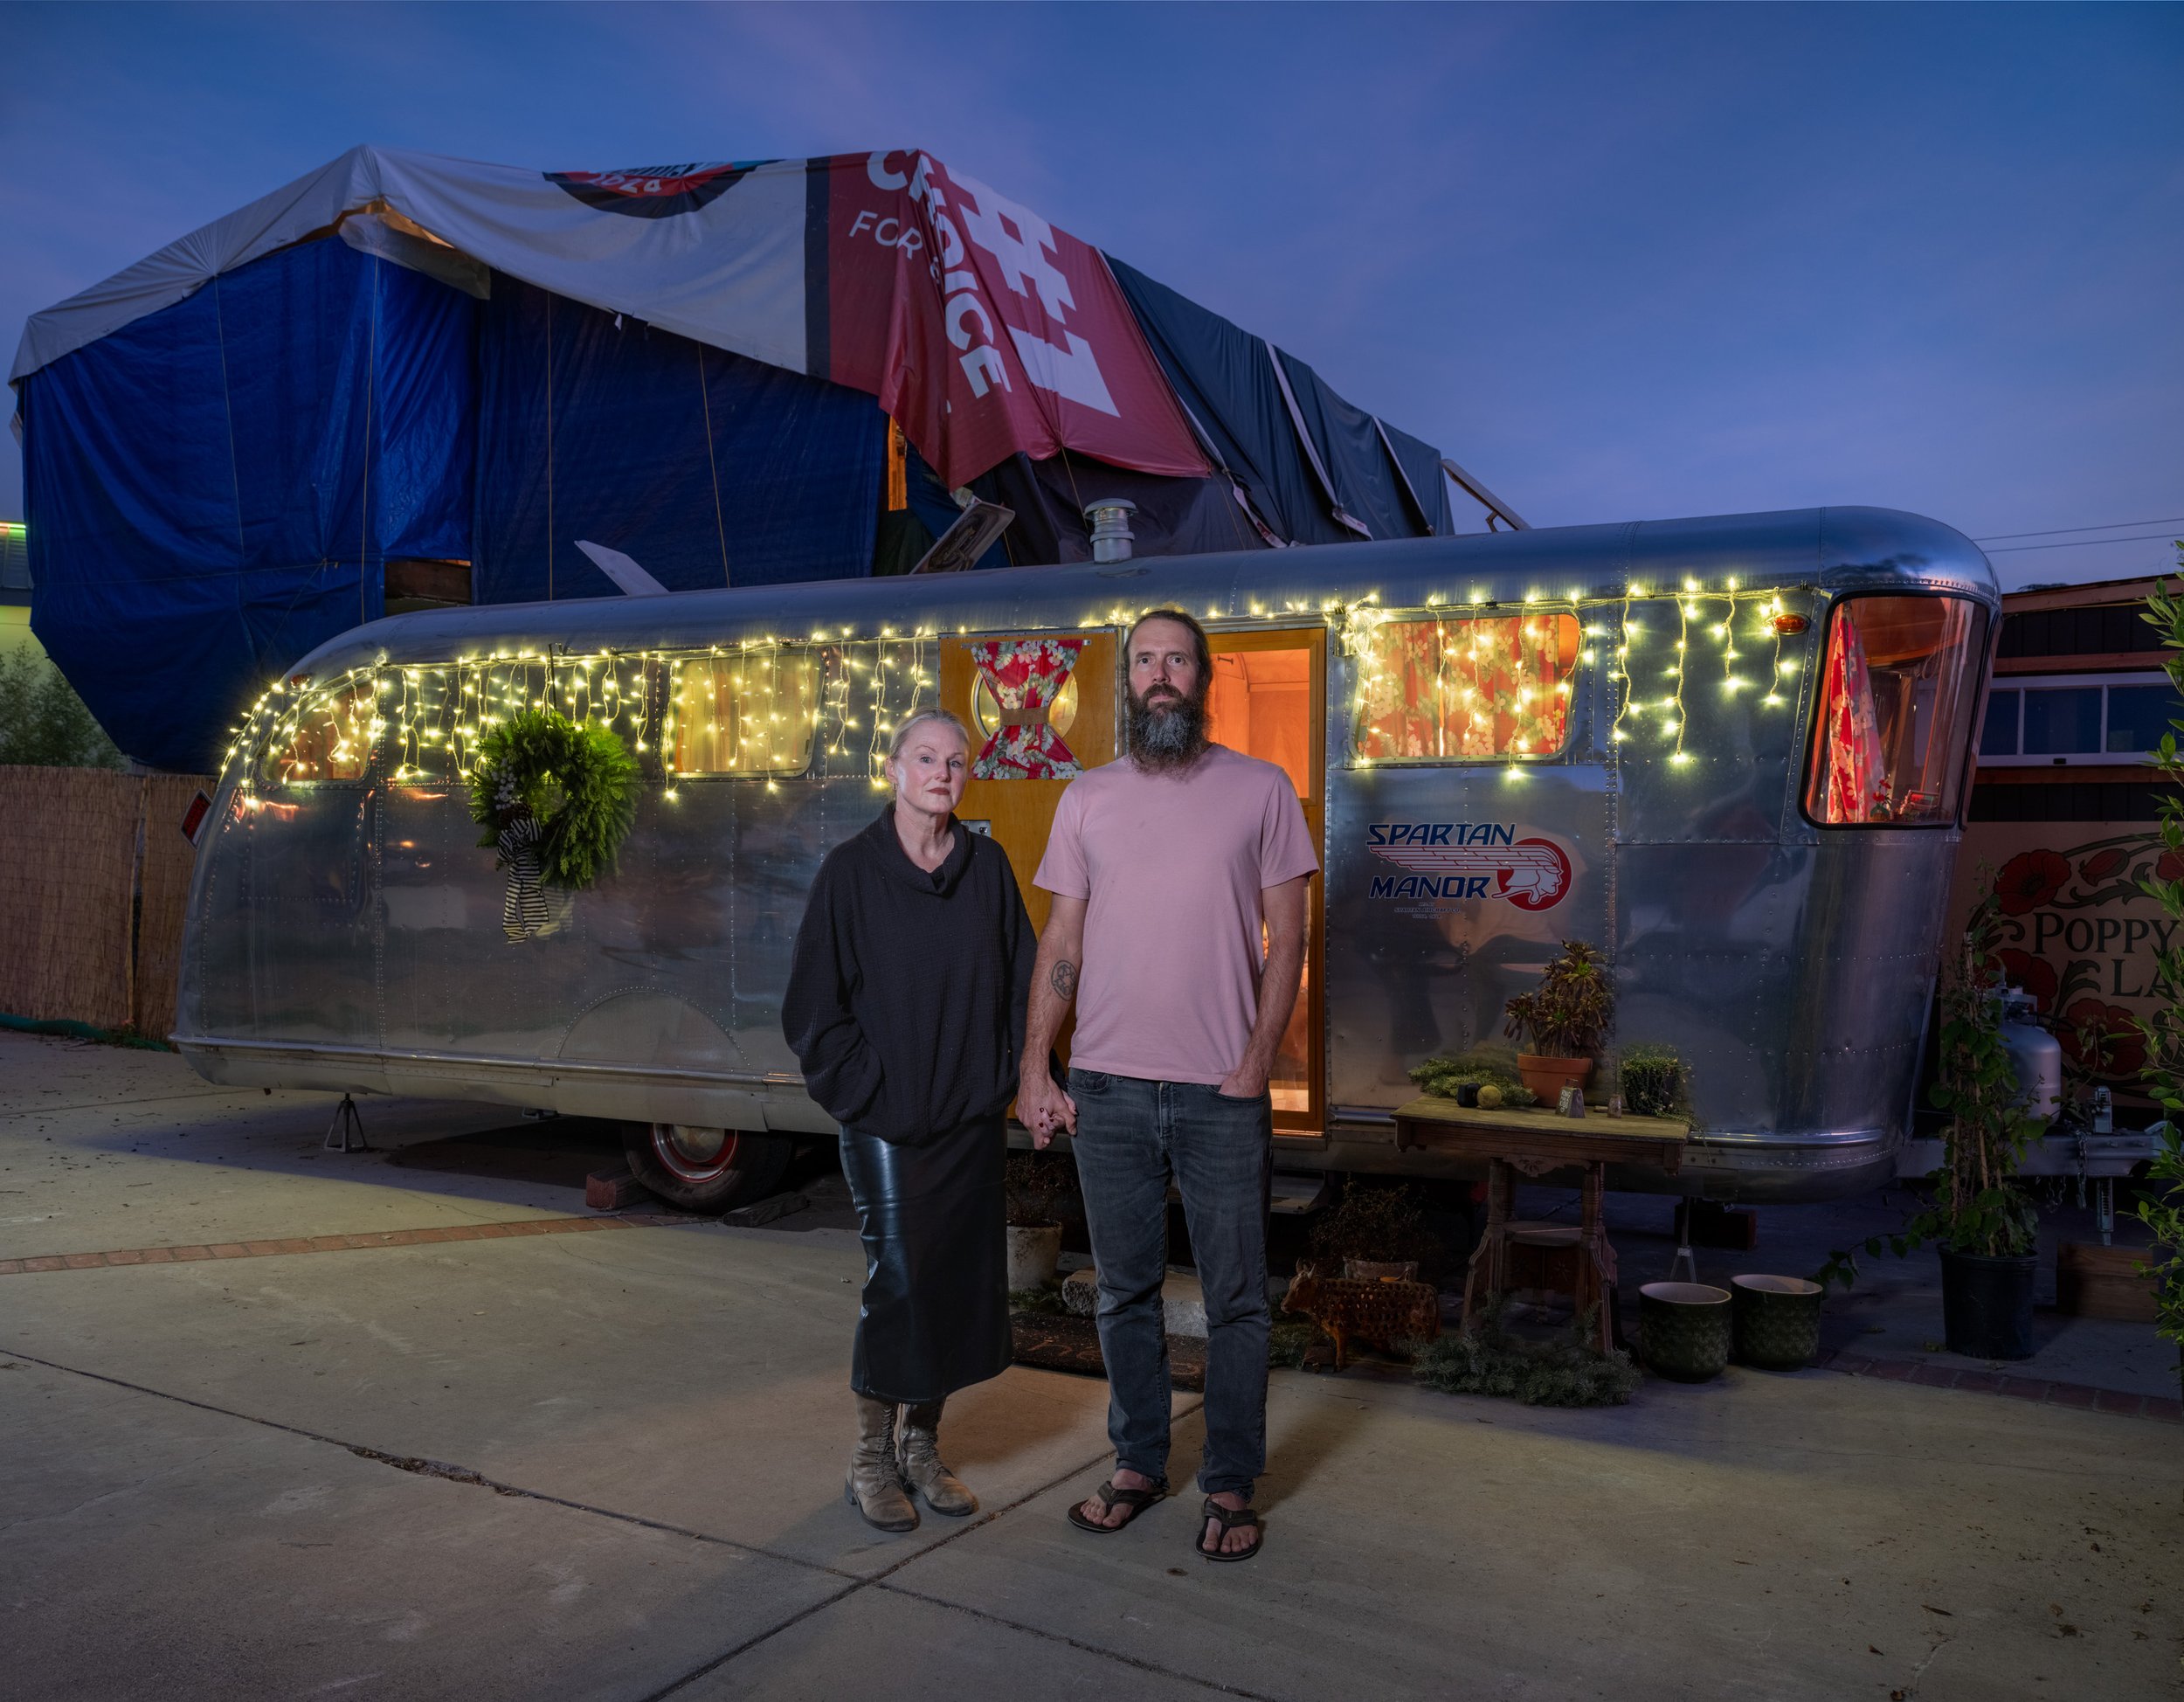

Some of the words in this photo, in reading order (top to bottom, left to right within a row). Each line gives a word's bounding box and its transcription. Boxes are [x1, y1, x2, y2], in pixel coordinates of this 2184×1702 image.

[849, 211, 923, 259] FOR
[1366, 823, 1516, 846] SPARTAN
[1369, 875, 1490, 899] MANOR
[2032, 912, 2181, 954] POPPY
